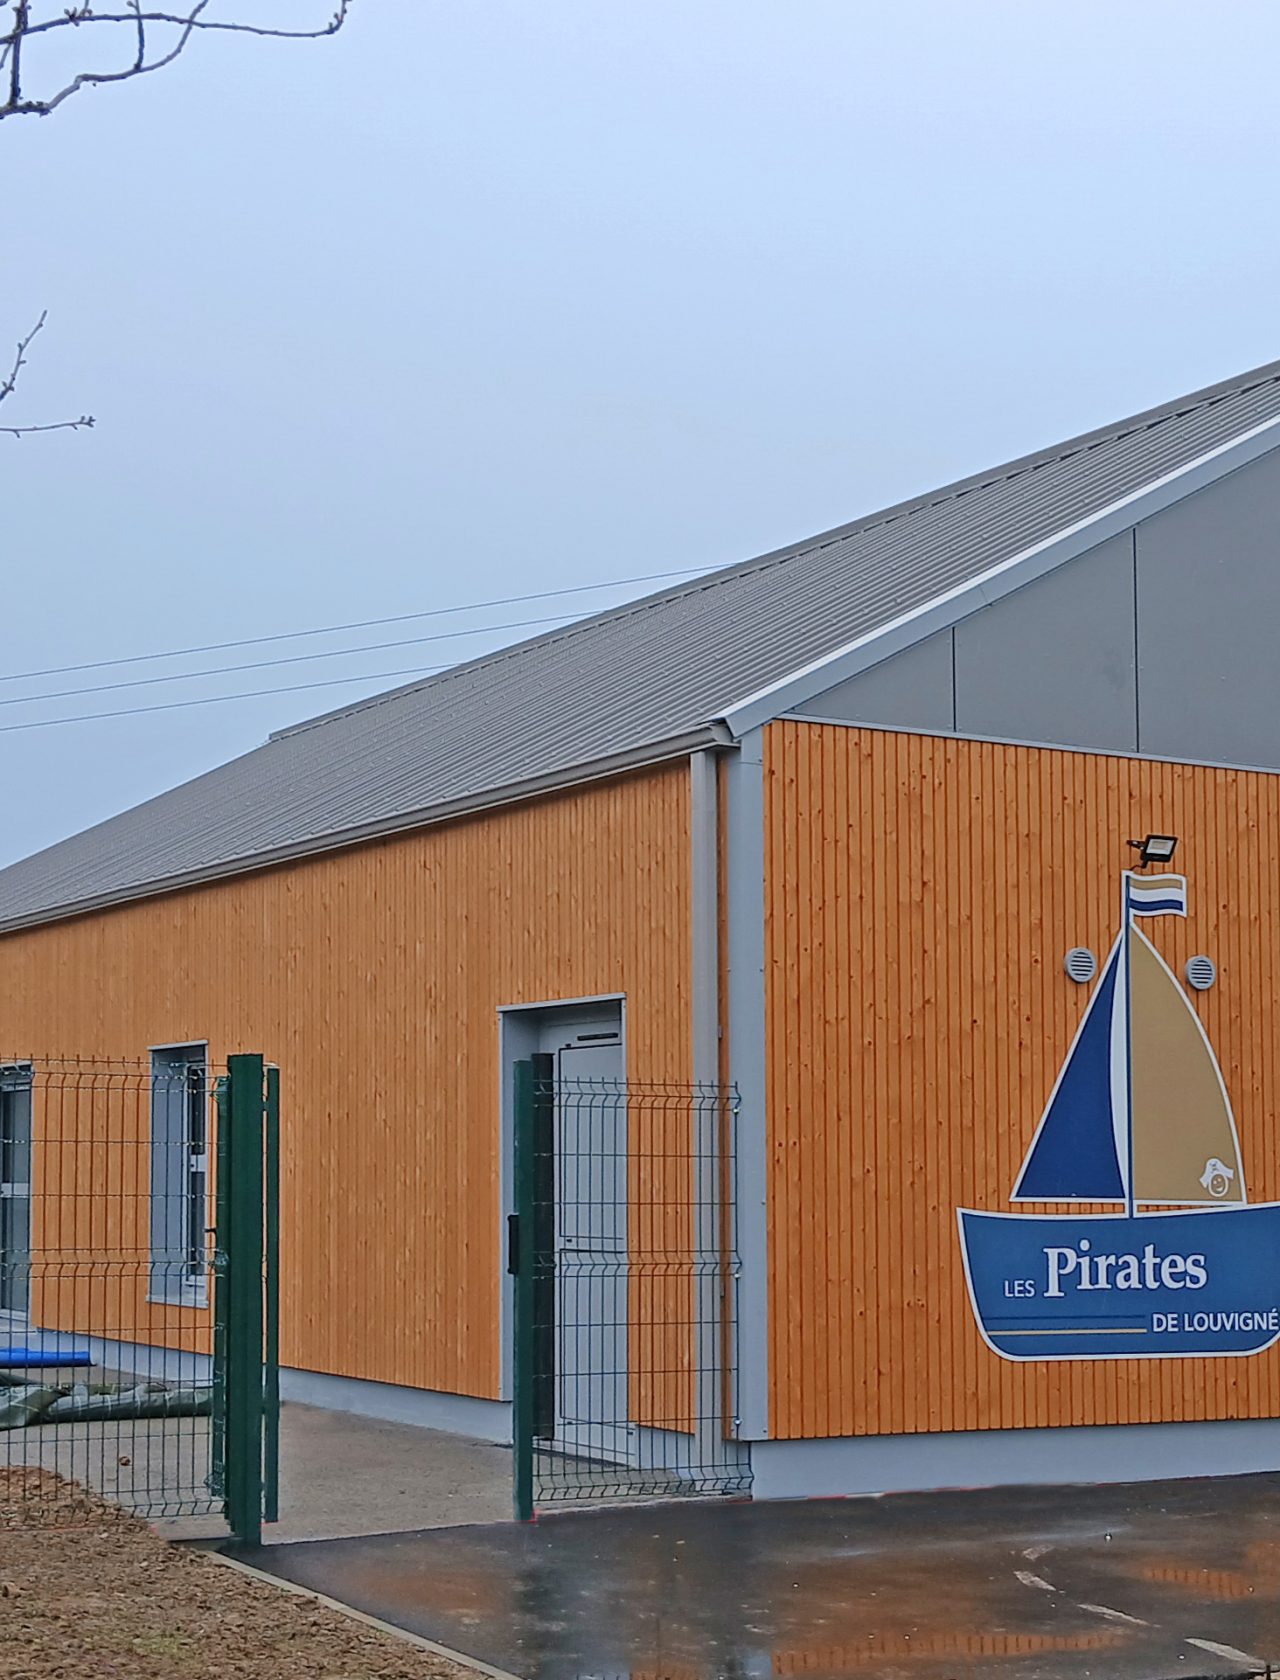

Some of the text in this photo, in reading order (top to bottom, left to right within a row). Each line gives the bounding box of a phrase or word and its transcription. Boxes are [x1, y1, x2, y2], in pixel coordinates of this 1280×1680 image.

[1004, 1239, 1208, 1298] LES Pirates
[1152, 1308, 1280, 1332] DE LOUVIGNÉ
